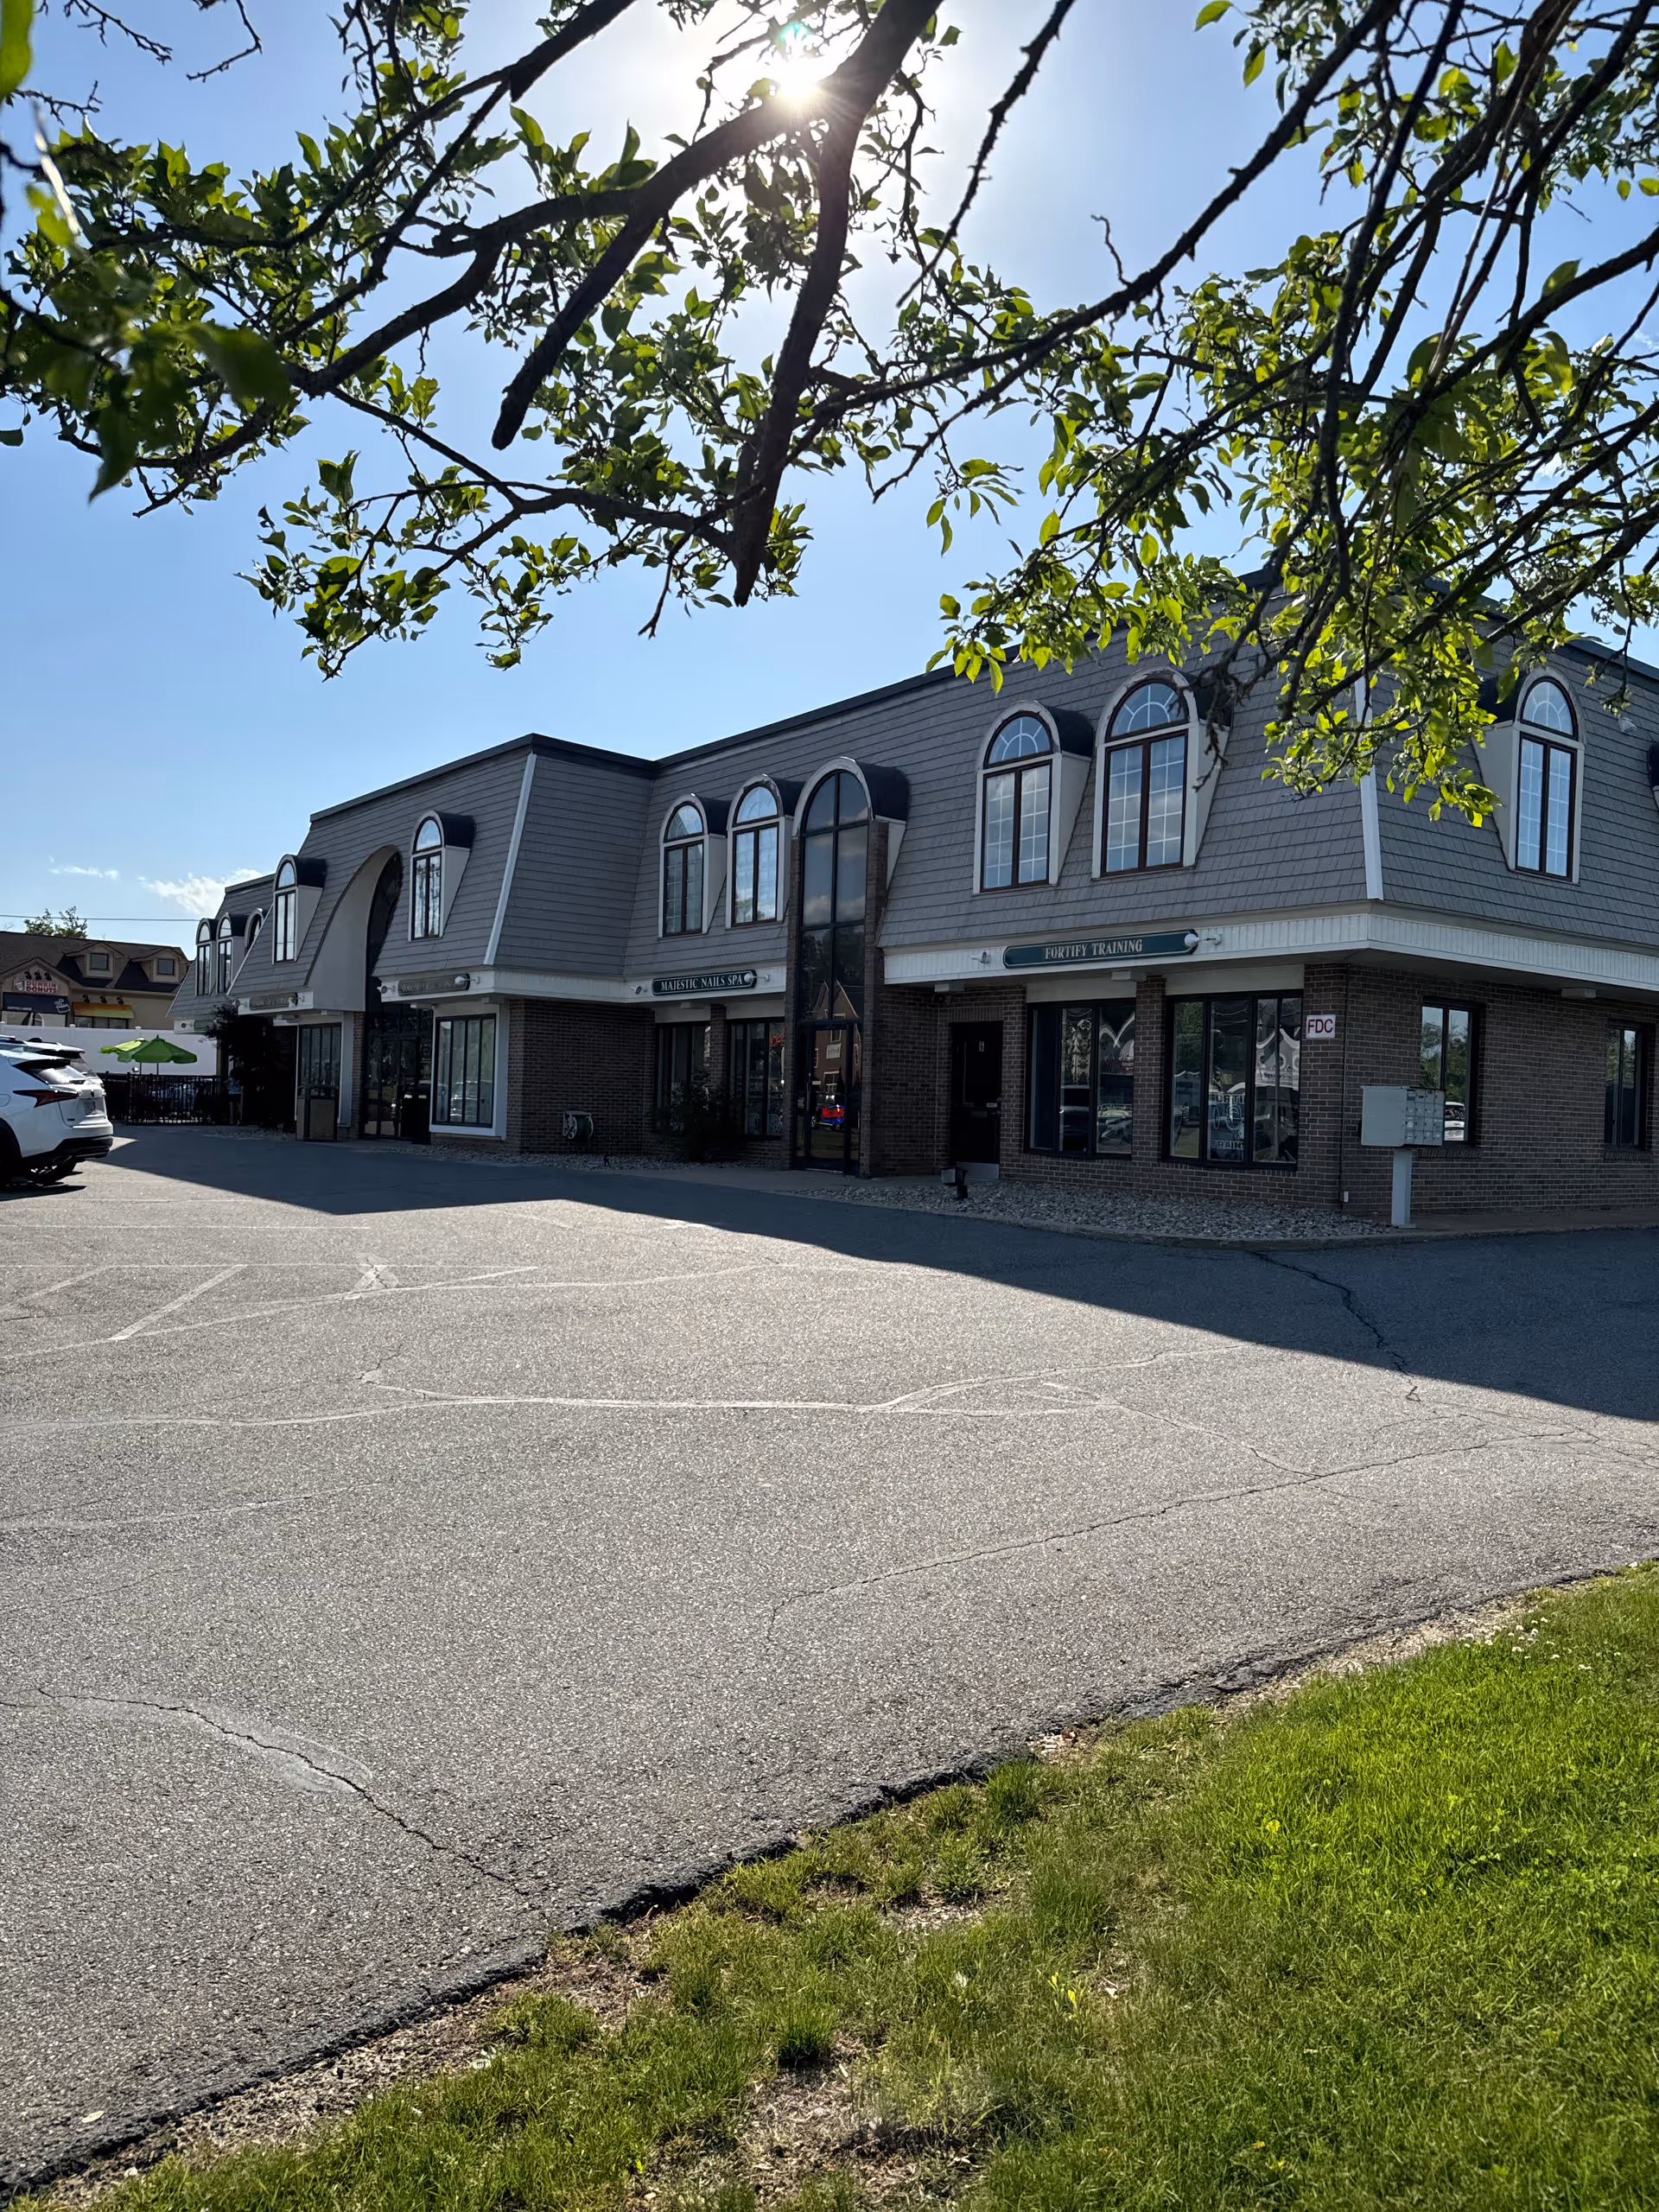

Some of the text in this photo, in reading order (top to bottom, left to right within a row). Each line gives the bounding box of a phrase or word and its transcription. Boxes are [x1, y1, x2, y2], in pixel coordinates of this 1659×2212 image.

[1045, 939, 1143, 959] FORTIFY TRAINING
[661, 975, 743, 991] MAJESTIC NAILS SPA
[1307, 1019, 1333, 1034] FDC
